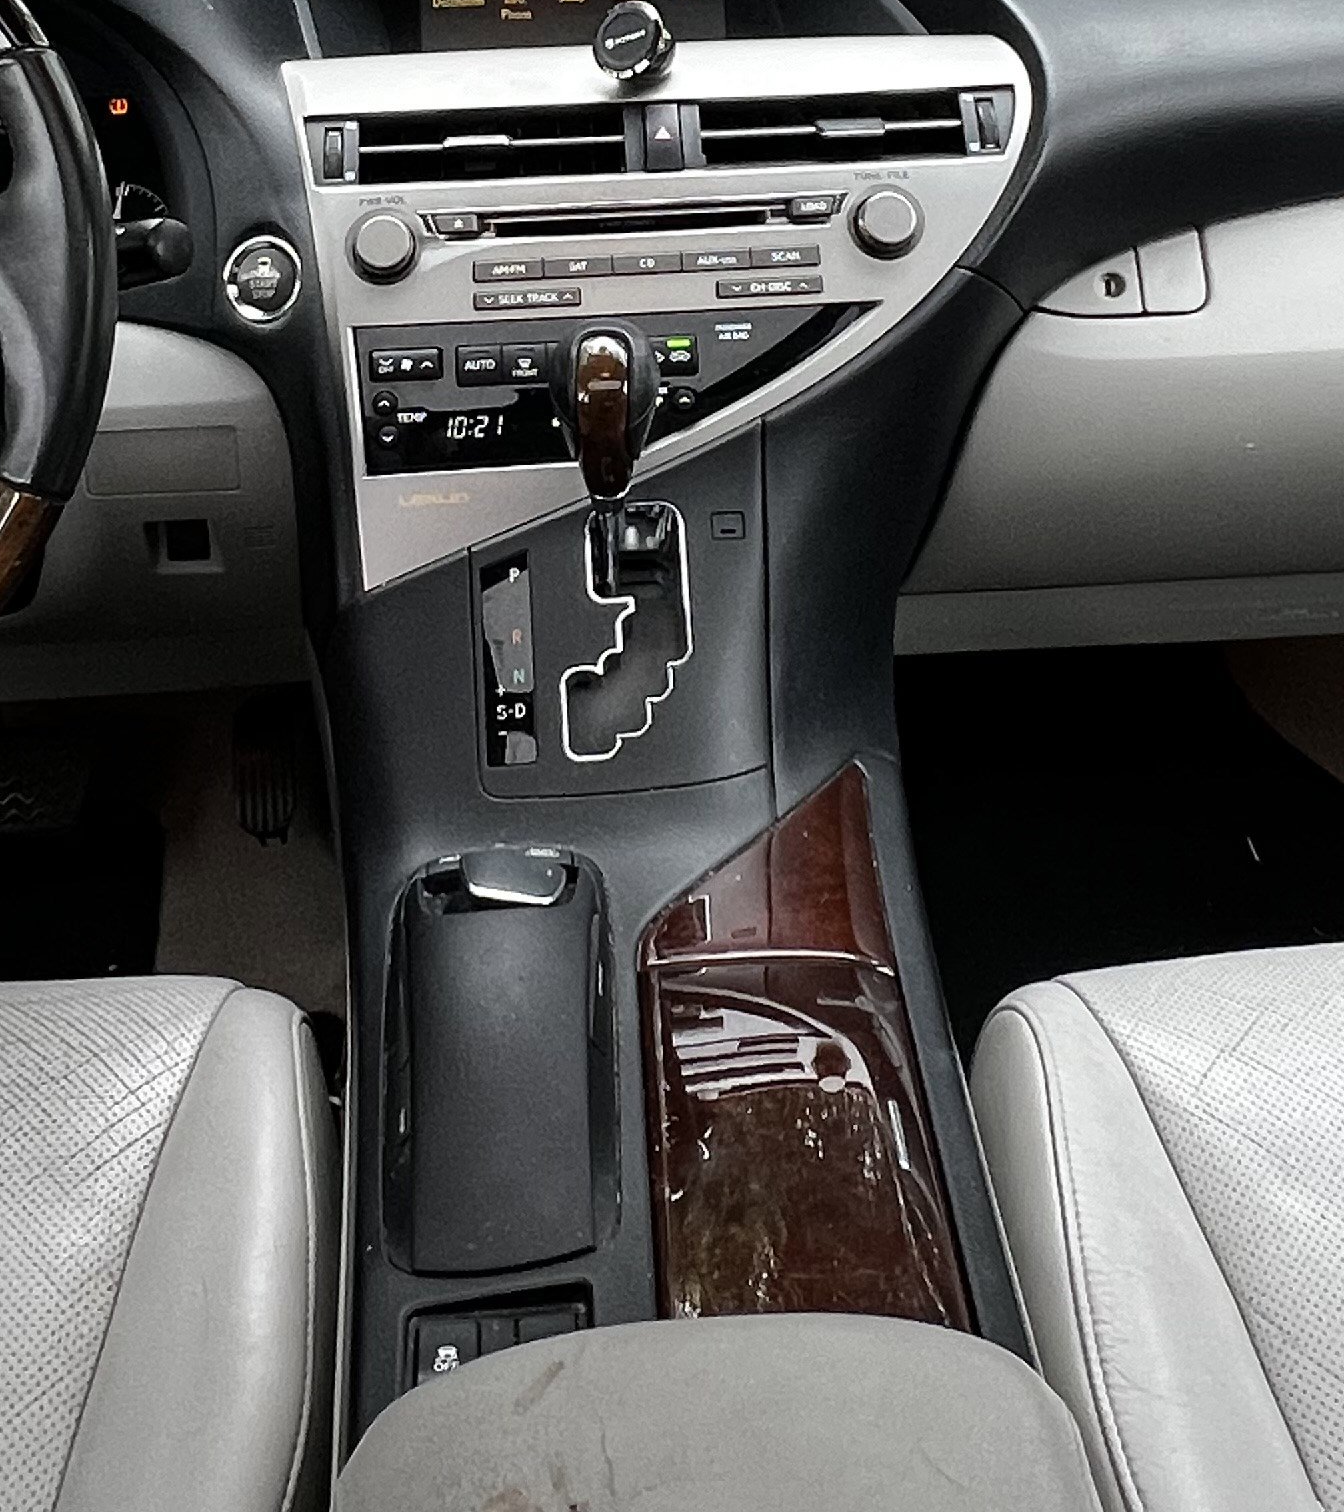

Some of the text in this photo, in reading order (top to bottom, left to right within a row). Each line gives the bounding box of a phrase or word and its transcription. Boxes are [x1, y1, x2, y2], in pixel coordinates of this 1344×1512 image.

[638, 257, 656, 268] CD
[771, 251, 802, 262] SCAN
[568, 260, 588, 272] SAT
[498, 291, 559, 305] SEEK TRACK
[464, 358, 496, 372] AUTO
[397, 411, 427, 424] TEMP
[446, 414, 504, 439] 10:21
[508, 567, 520, 584] P
[512, 628, 523, 646] R
[513, 668, 526, 684] N
